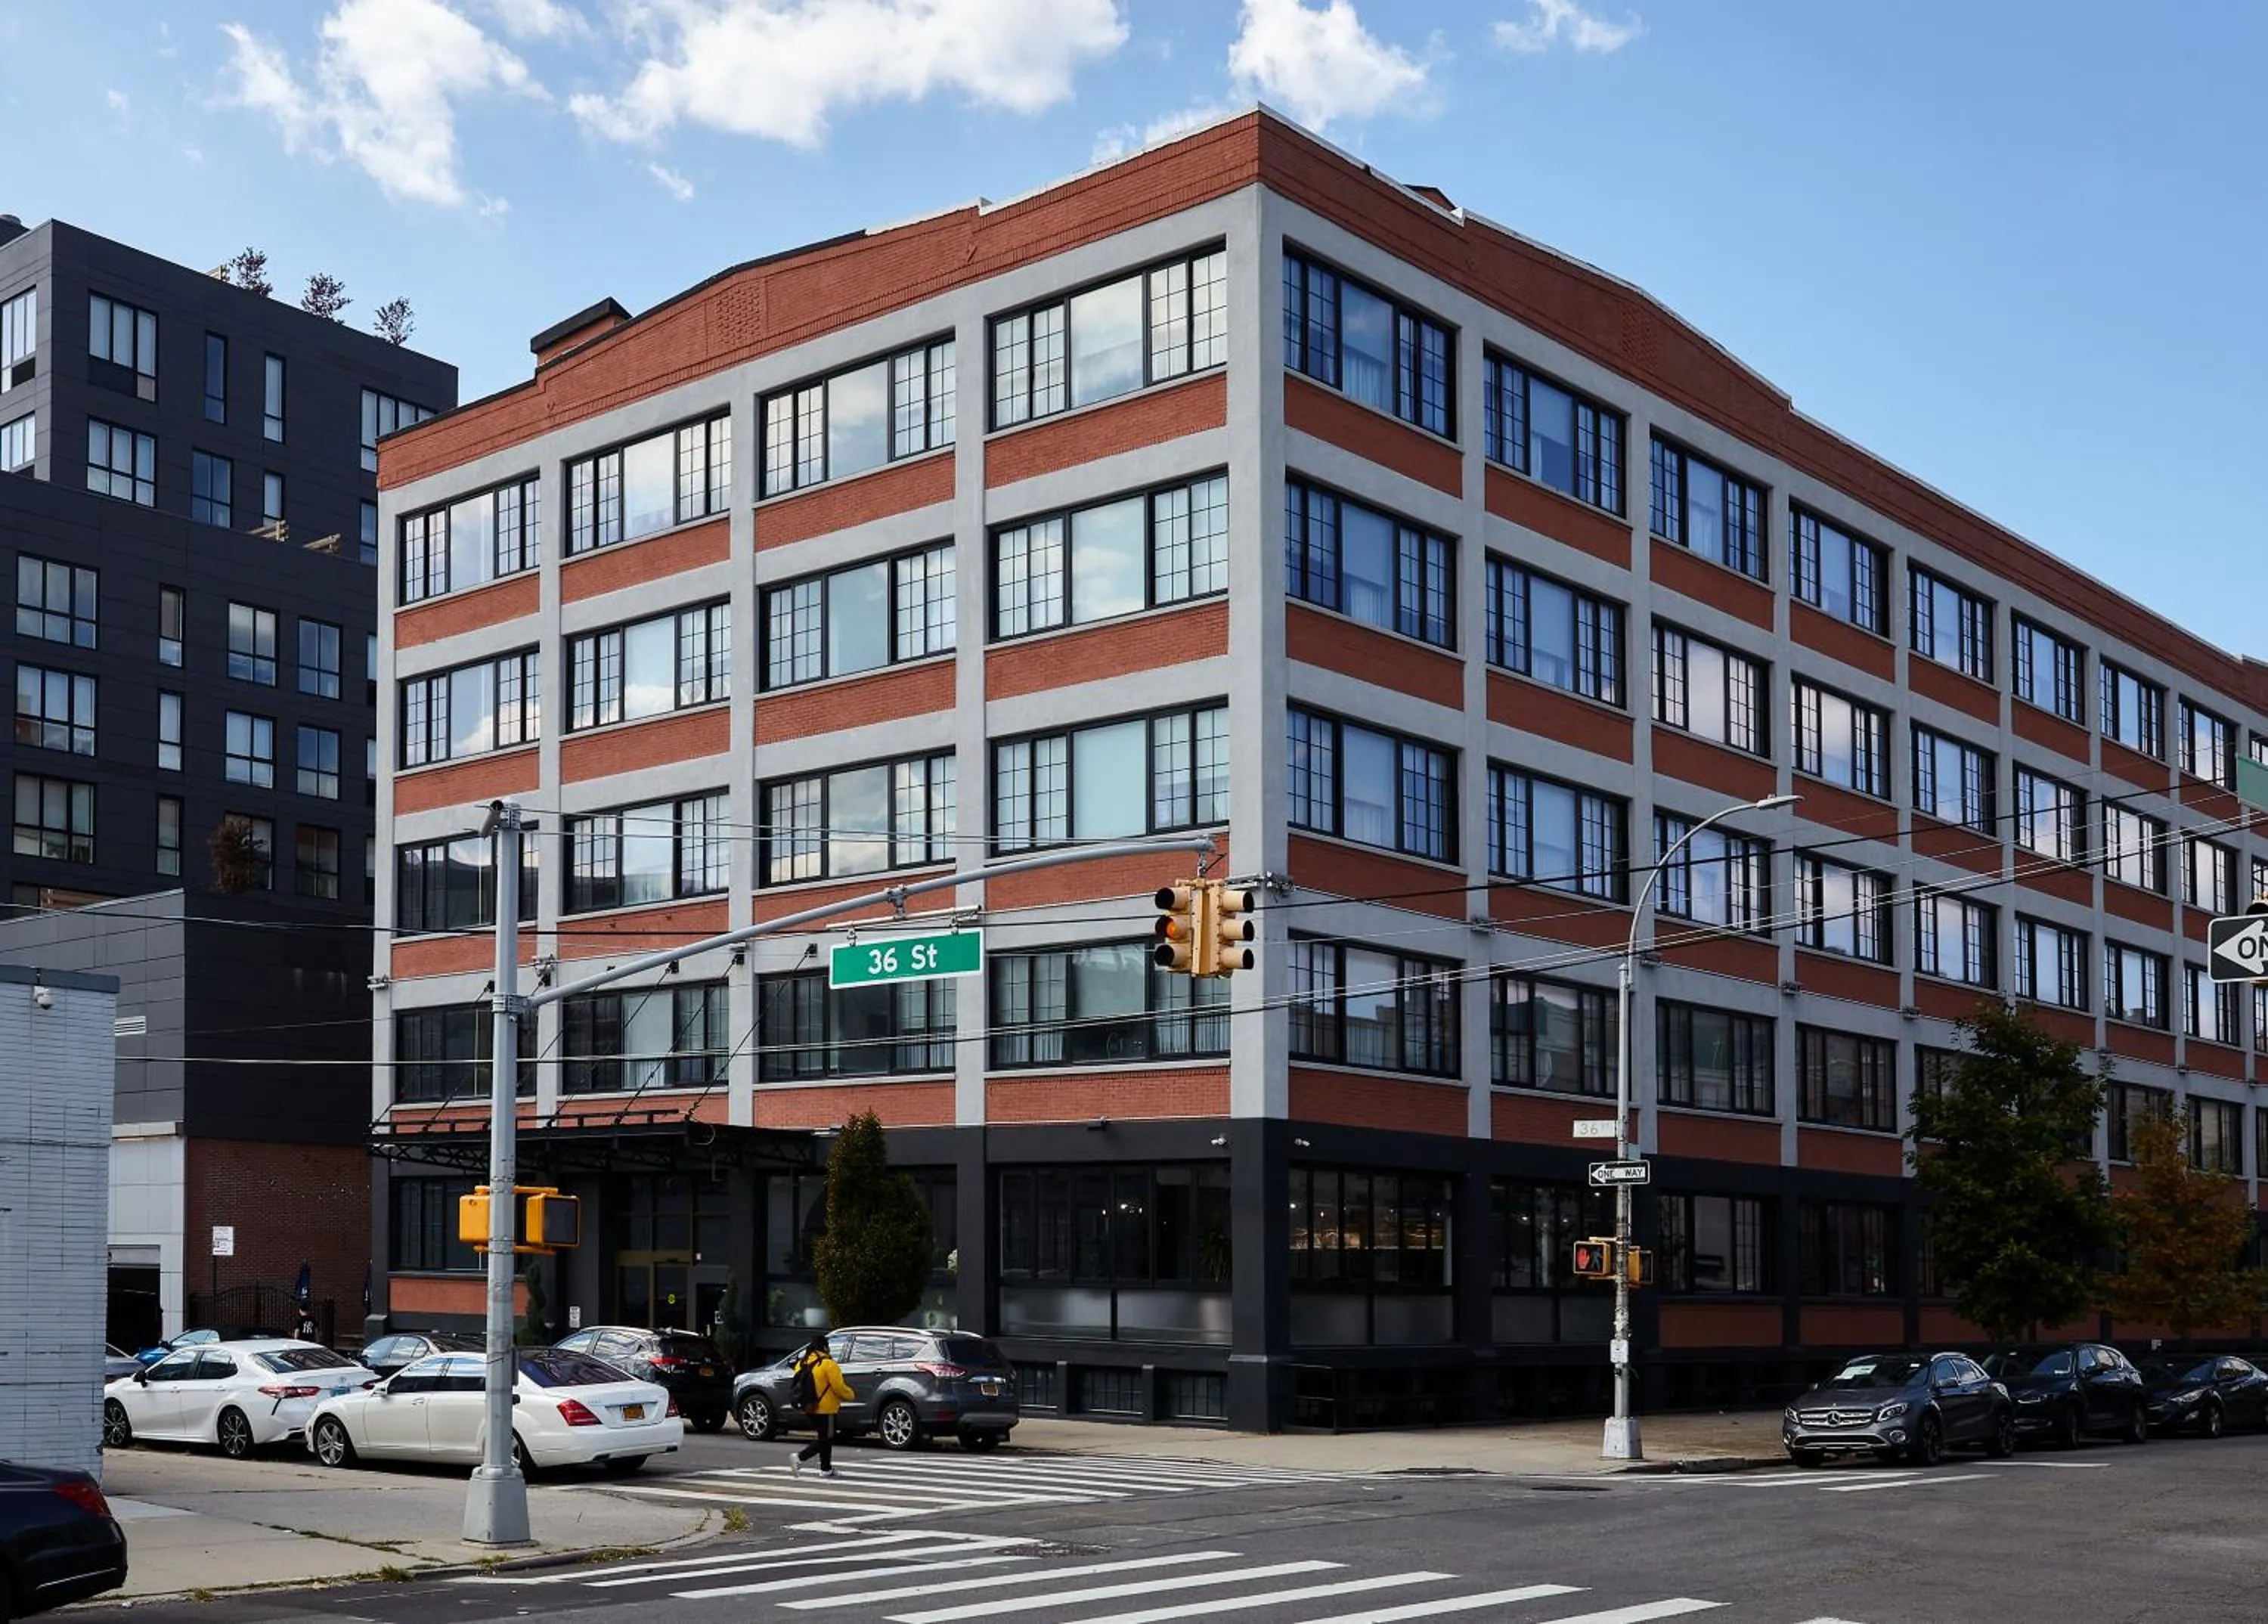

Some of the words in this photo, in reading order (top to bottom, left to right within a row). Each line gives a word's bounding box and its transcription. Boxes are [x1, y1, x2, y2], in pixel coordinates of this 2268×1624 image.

[868, 949, 897, 974] 36
[911, 944, 937, 970] St
[1579, 1123, 1598, 1135] 36
[1597, 1170, 1616, 1179] ONE
